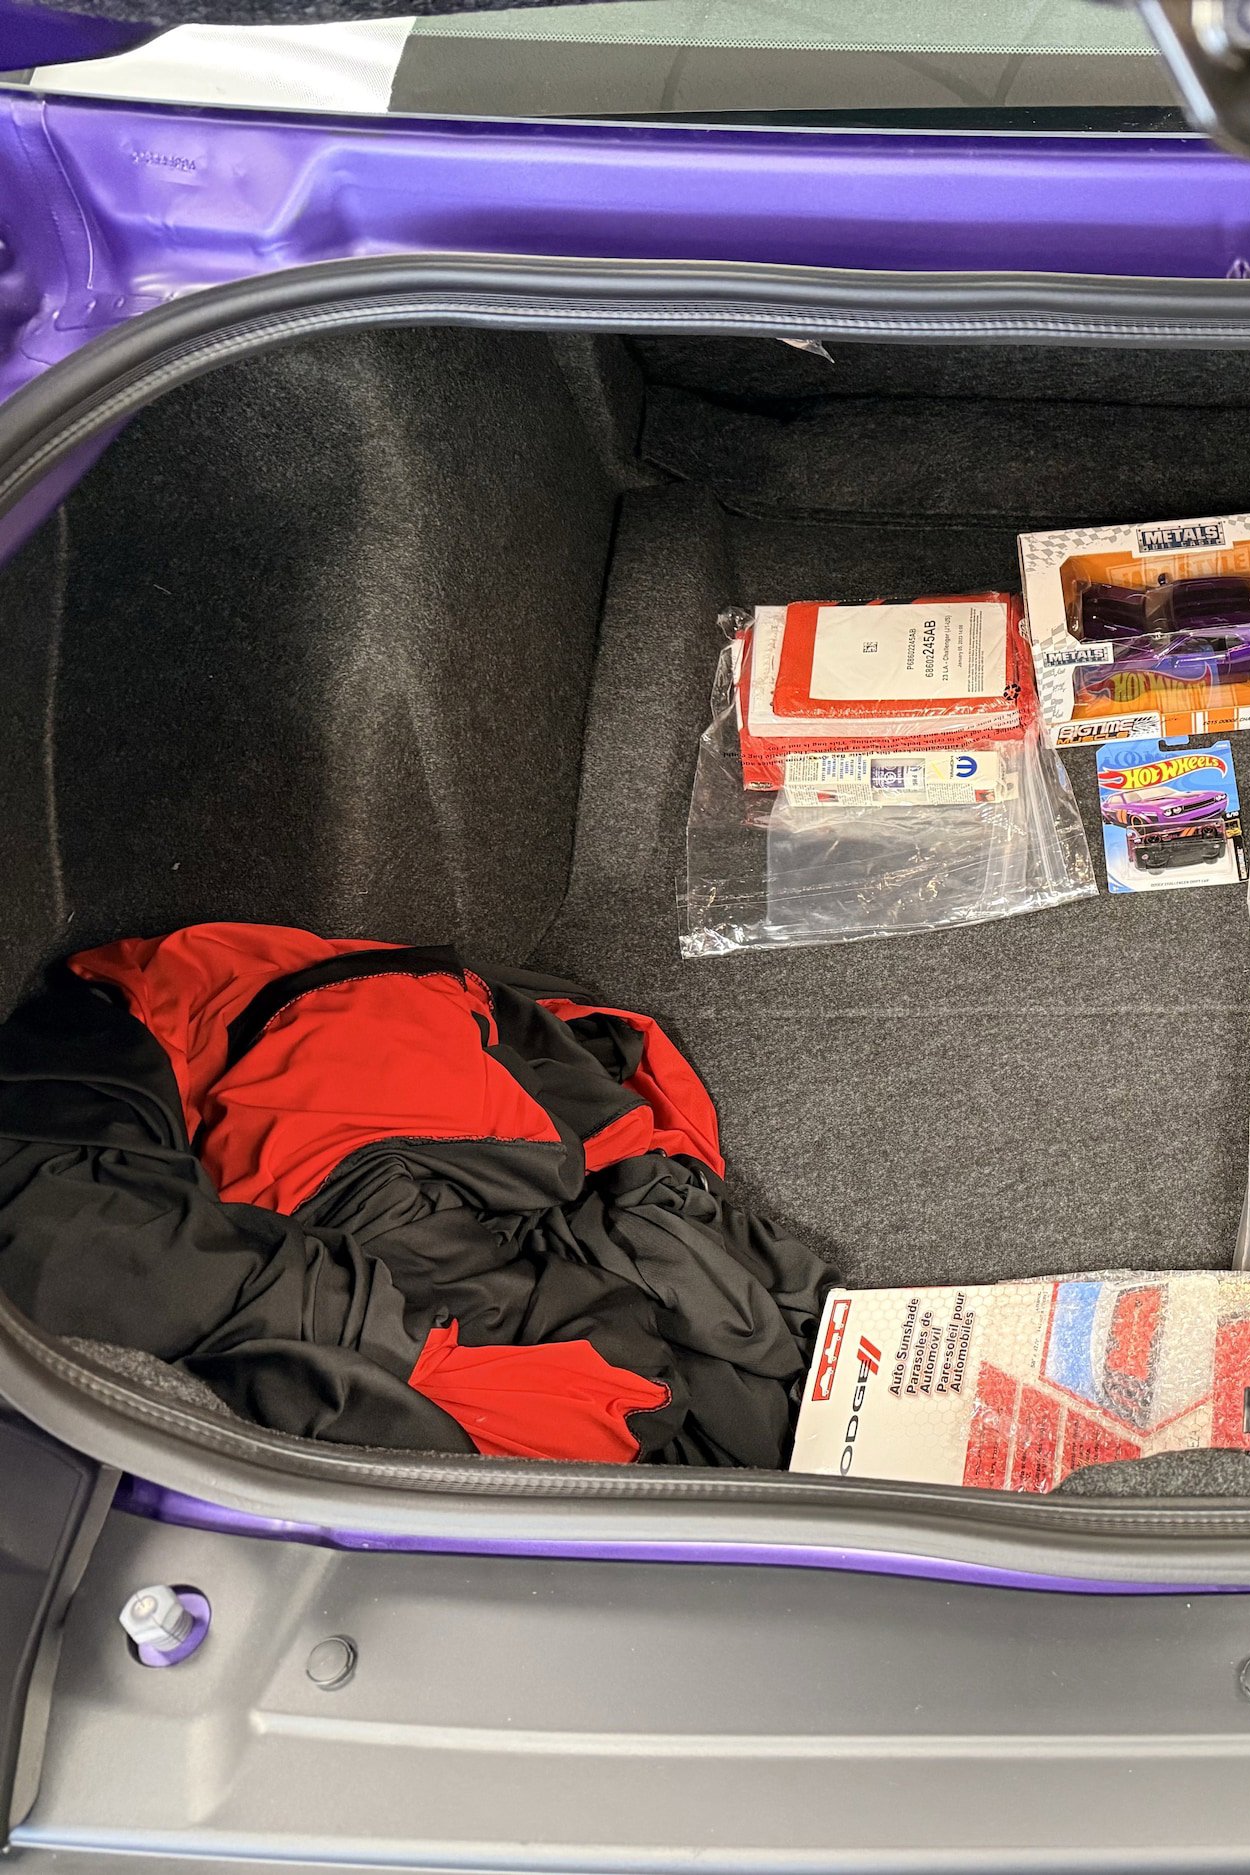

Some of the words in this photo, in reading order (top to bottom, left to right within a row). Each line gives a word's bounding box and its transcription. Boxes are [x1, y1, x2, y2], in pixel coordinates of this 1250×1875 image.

[1144, 524, 1218, 545] METALS
[906, 627, 916, 670] P68602245AB
[922, 619, 936, 677] 68602245AB
[941, 633, 951, 661] Challenger
[1048, 649, 1103, 661] METALS
[941, 664, 949, 673] LA
[941, 673, 949, 681] 23
[1055, 730, 1130, 746] MUSCLE
[1056, 717, 1135, 739] BIGTIME
[764, 749, 791, 759] plastic
[849, 749, 874, 757] plastic
[1121, 767, 1161, 789] HOT
[896, 1298, 918, 1359] Sunshade
[936, 1323, 958, 1392] Pare-soleil
[952, 1292, 964, 1321] pour
[905, 1331, 928, 1393] Parasoles
[920, 1311, 932, 1327] de
[919, 1327, 941, 1393] Automóvil
[950, 1312, 973, 1391] Automobiles
[889, 1363, 904, 1395] Auto
[839, 1356, 871, 1476] ODGE
